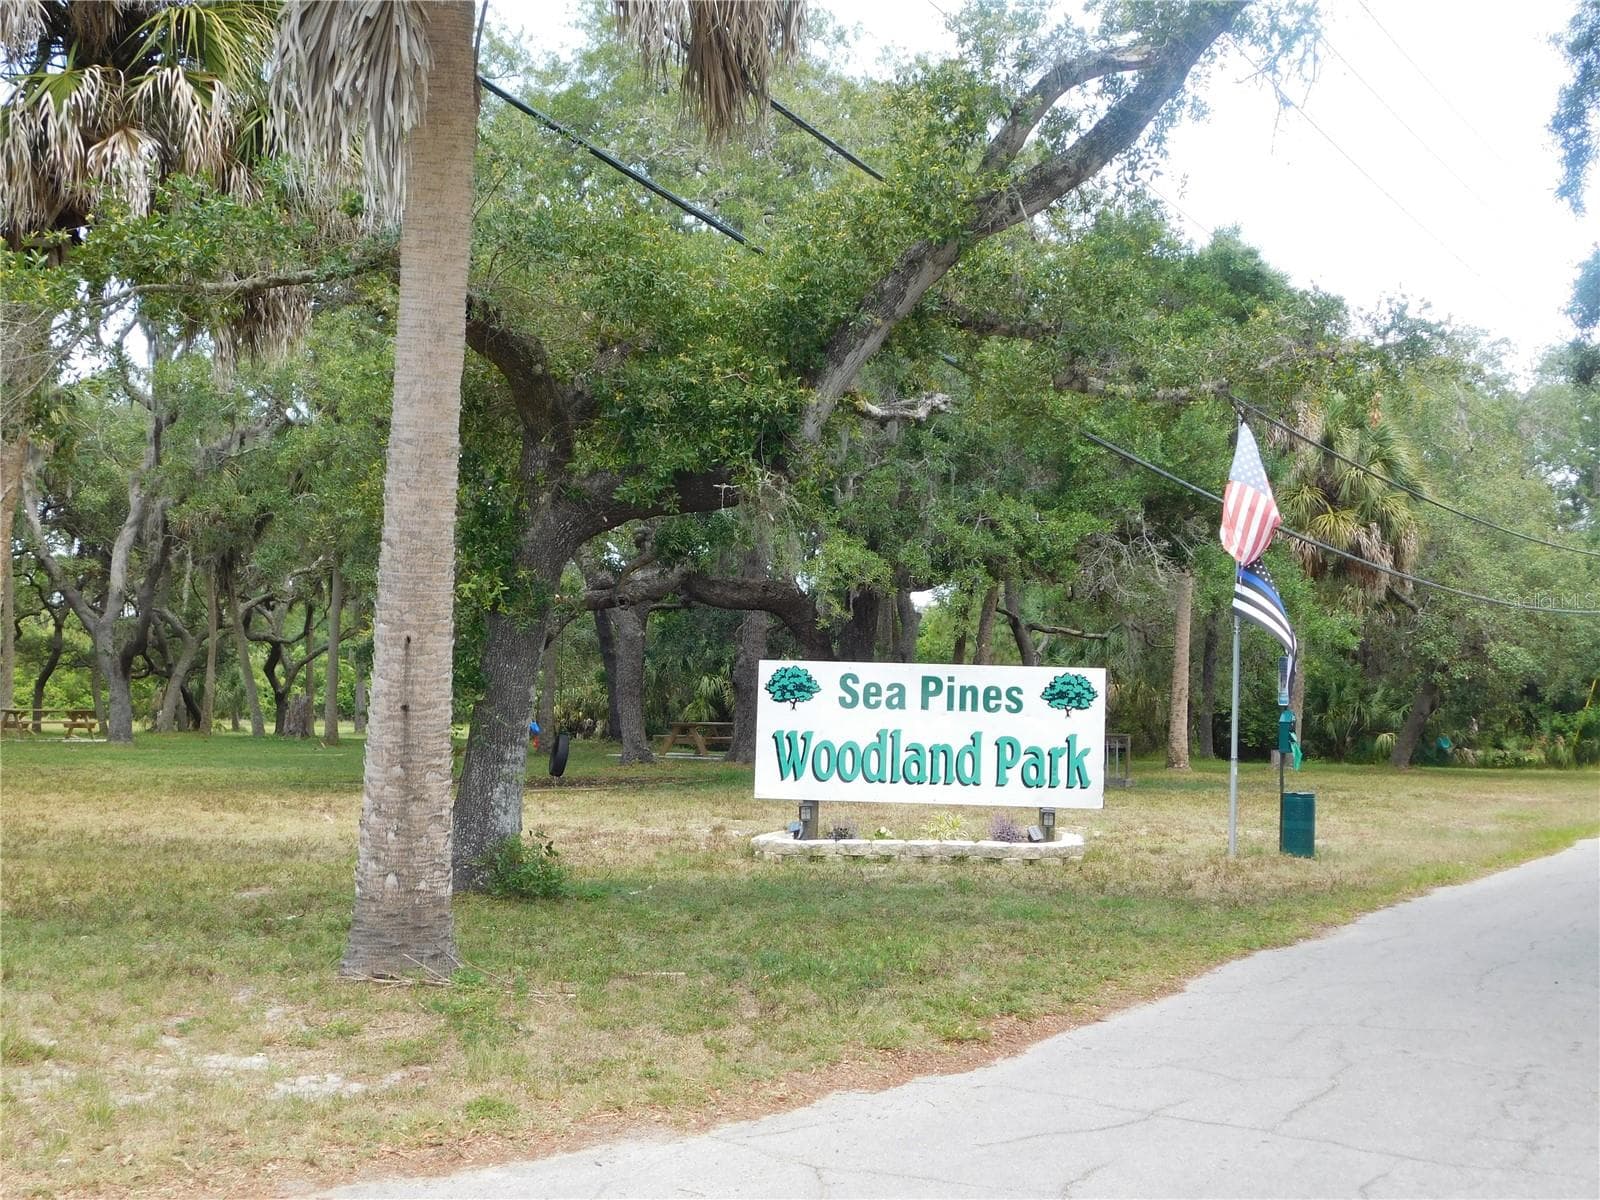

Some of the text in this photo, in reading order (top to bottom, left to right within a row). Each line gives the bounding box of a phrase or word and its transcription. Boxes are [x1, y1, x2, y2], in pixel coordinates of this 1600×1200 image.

[839, 672, 1024, 713] Sea Pines
[772, 728, 1092, 789] Woodland Park
